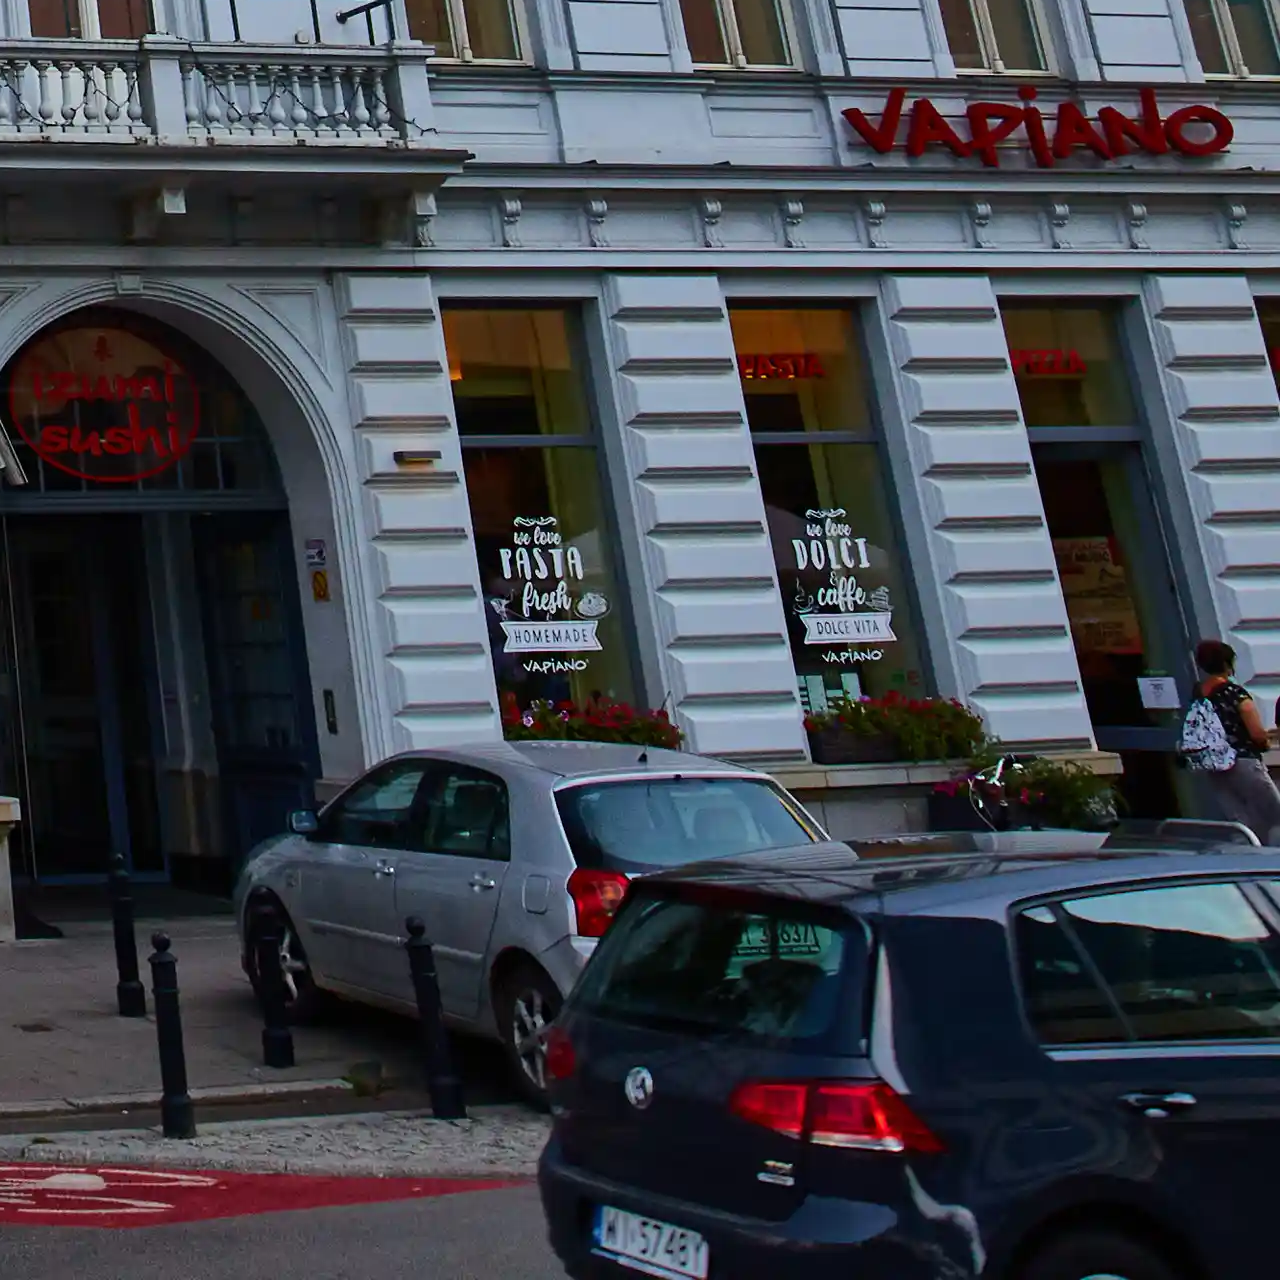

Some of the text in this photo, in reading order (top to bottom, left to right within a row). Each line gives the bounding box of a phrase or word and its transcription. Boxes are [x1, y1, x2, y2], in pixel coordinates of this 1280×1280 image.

[33, 360, 176, 401] izumi
[40, 403, 178, 457] sushi
[513, 526, 562, 545] we love
[806, 518, 851, 536] we love
[499, 547, 583, 580] PASTA
[792, 538, 870, 570] DOLCI
[522, 580, 571, 618] fresh
[817, 576, 866, 612] caffe
[515, 629, 588, 643] HOMEMADE
[817, 620, 880, 634] DOLCE VITA
